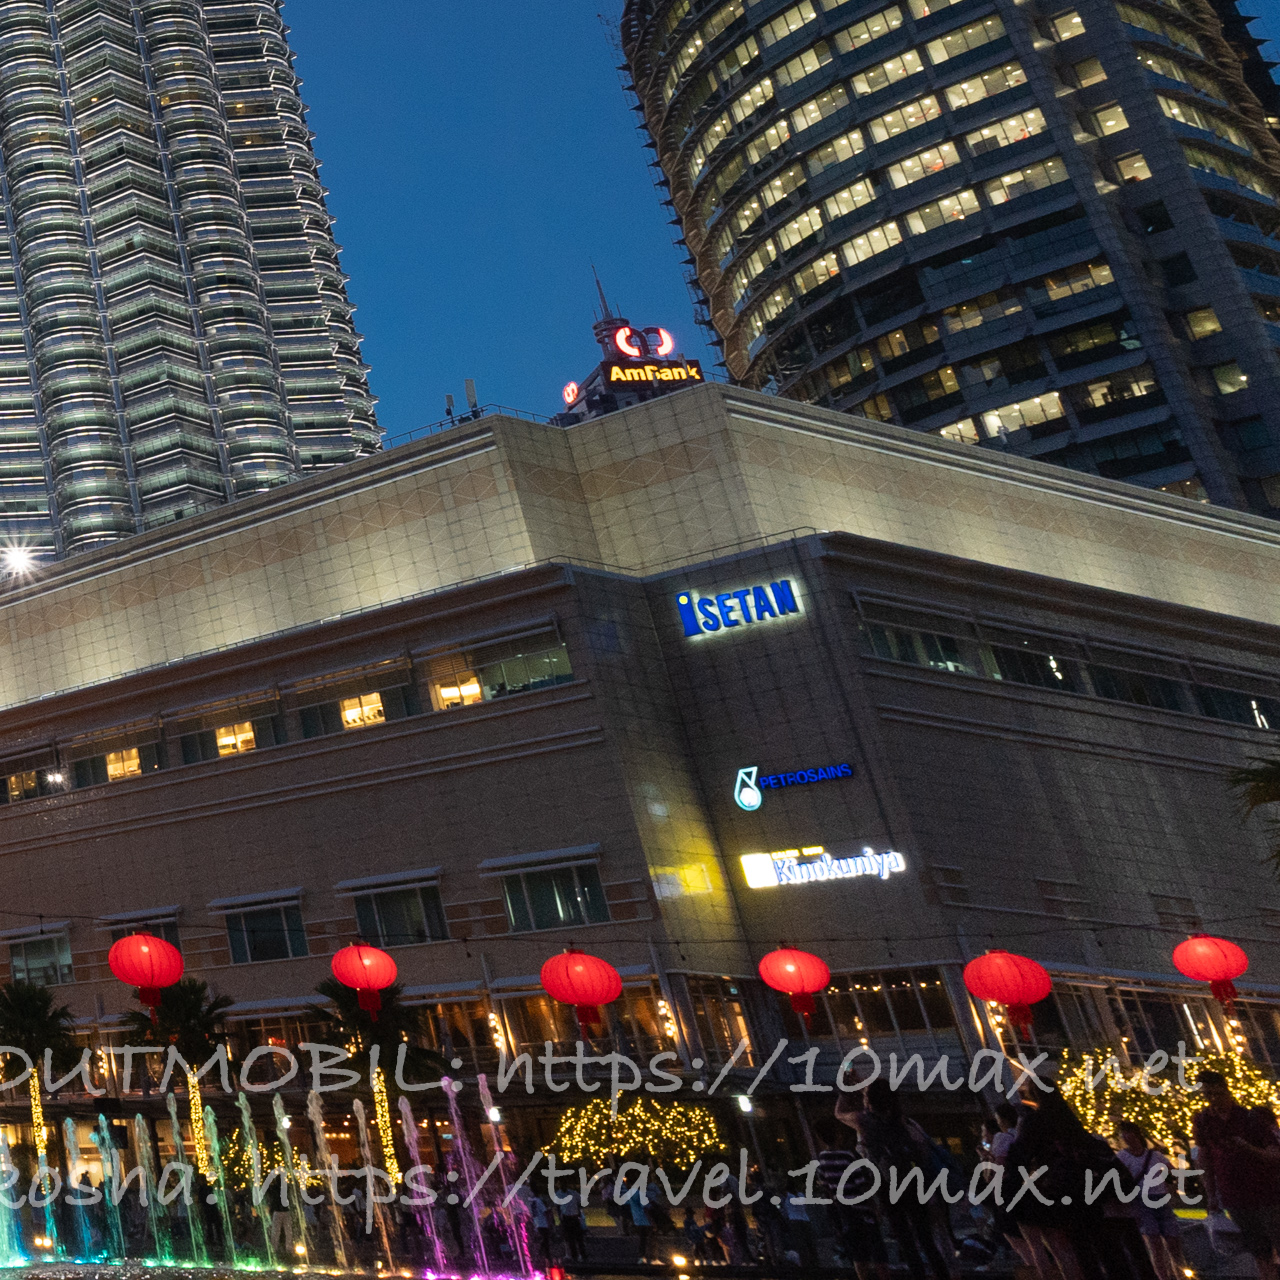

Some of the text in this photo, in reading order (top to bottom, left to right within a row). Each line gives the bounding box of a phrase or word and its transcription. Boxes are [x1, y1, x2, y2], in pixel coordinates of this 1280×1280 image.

[610, 365, 701, 381] AmBank
[759, 763, 852, 789] PETROSAINS
[773, 846, 906, 880] Kinokuniya
